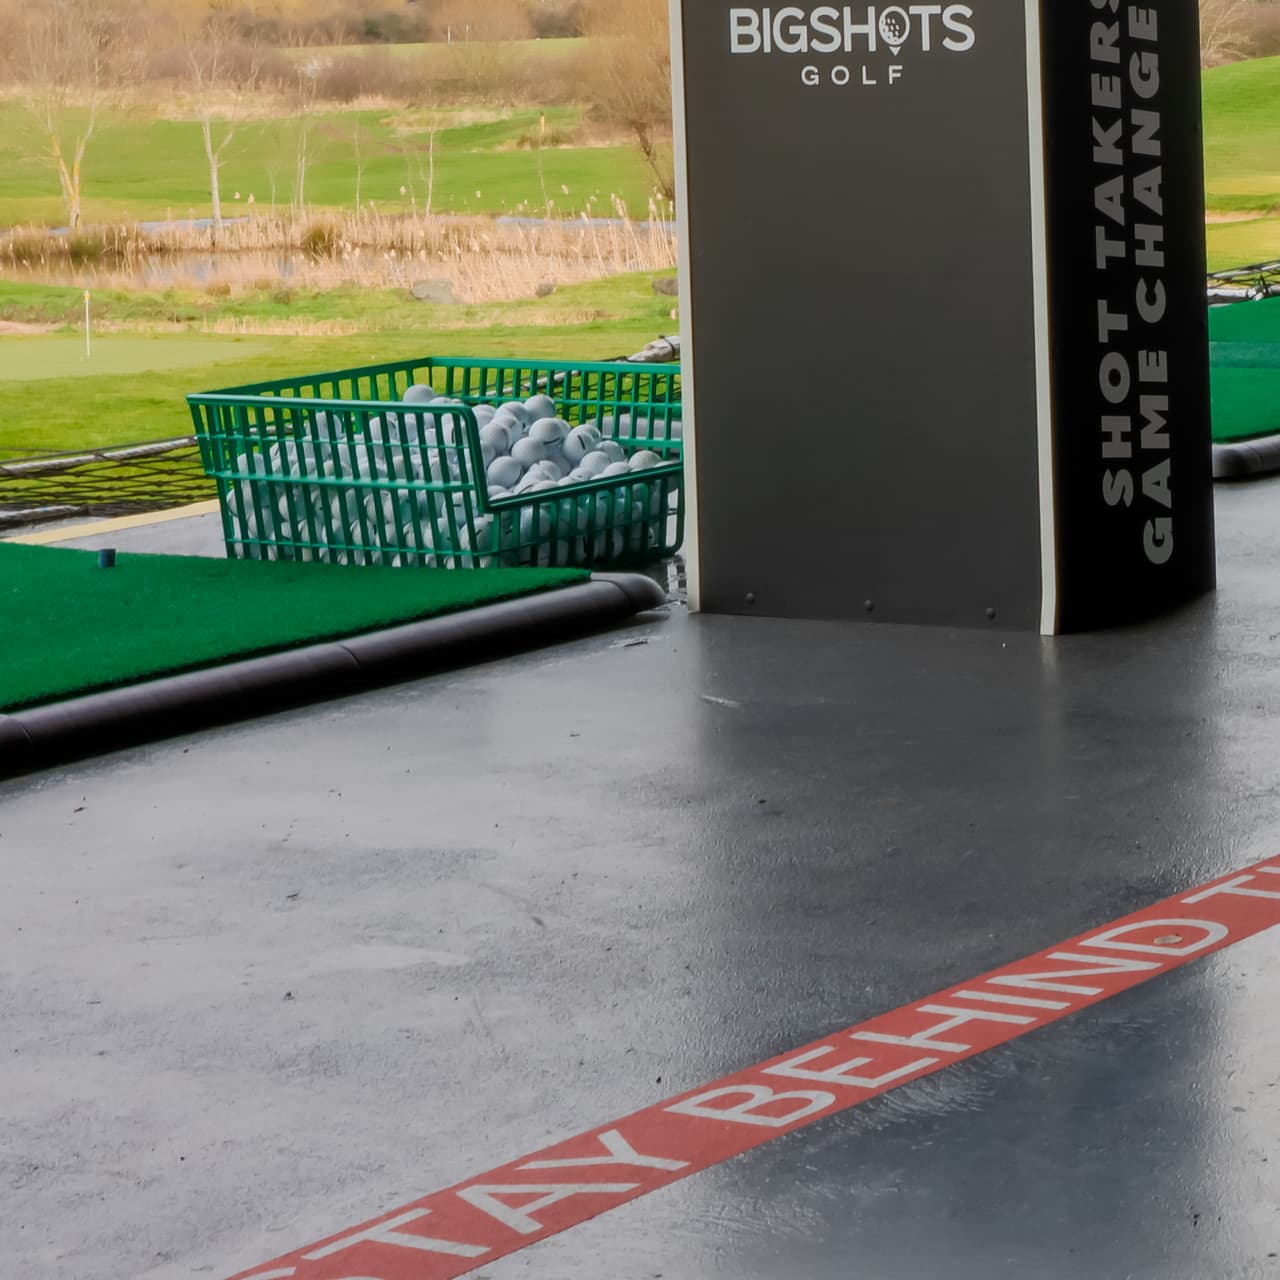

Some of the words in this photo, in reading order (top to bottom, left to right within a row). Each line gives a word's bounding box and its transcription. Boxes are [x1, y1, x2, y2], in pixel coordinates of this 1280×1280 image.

[729, 4, 976, 56] BIGSHOTS
[801, 65, 904, 86] GOLF
[1097, 300, 1133, 508] SHOT
[1138, 349, 1175, 566] GAME
[225, 1130, 691, 1280] TAY
[664, 916, 1228, 1128] BEHIND
